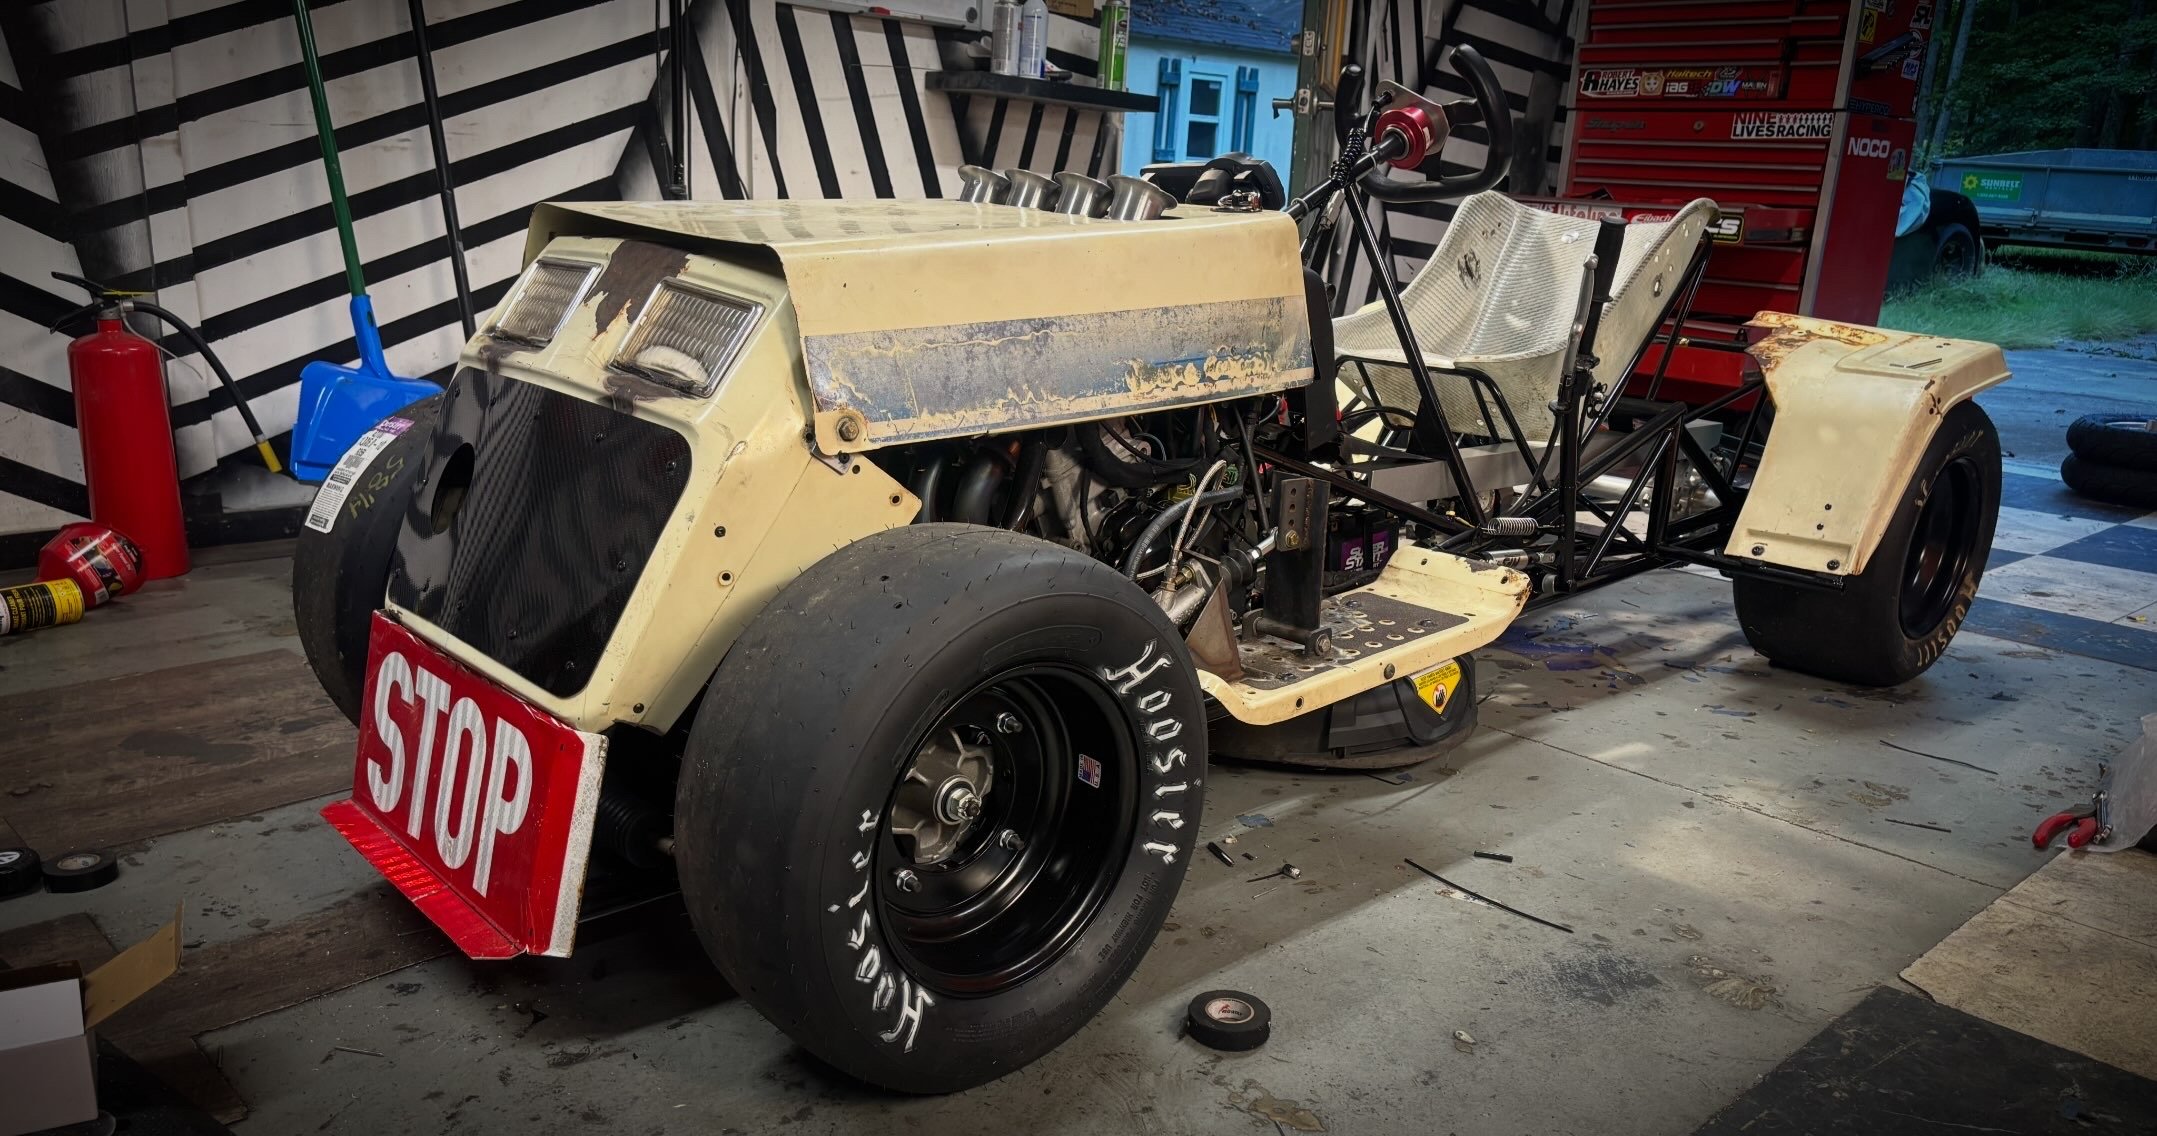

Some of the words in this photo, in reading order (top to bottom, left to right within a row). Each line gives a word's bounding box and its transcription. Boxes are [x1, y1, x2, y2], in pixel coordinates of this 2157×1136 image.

[1601, 70, 1634, 79] ROBERT
[1599, 78, 1639, 92] HAYES
[1709, 80, 1740, 93] DW
[1733, 113, 1777, 125] NINE
[1848, 136, 1891, 159] NOCO
[367, 651, 533, 899] STOP
[1129, 893, 1144, 912] FOR
